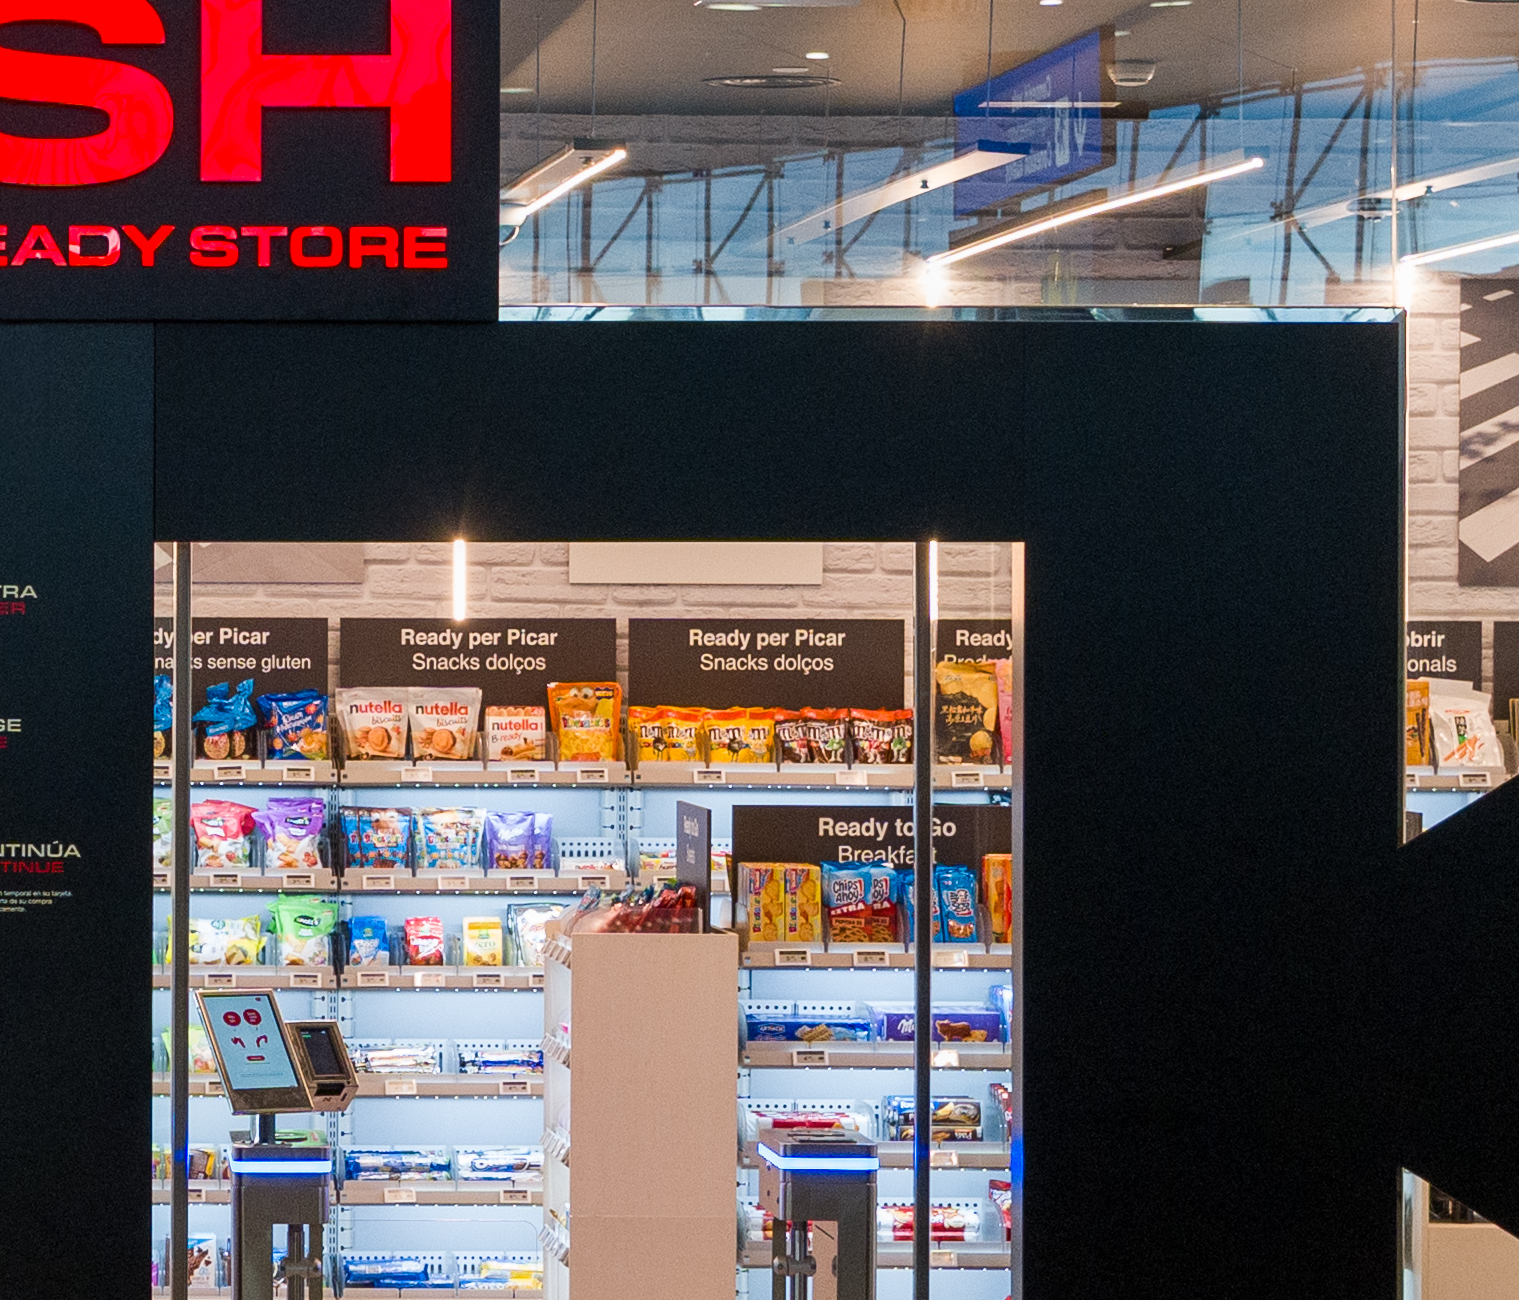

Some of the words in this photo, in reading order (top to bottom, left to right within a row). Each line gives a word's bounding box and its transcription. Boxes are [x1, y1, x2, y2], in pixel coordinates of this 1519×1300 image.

[189, 223, 449, 268] STORE
[219, 627, 270, 645] Picar
[401, 628, 463, 650] Ready
[469, 631, 501, 650] per
[507, 628, 558, 646] Picar
[689, 628, 751, 651] Ready
[756, 632, 789, 651] per
[795, 628, 846, 647] Picar
[956, 629, 1012, 651] Ready
[207, 657, 256, 670] sense
[261, 654, 312, 674] gluten
[412, 653, 480, 671] Snacks
[485, 653, 547, 675] dolços
[700, 653, 769, 672] Snacks
[773, 653, 834, 676] dolços
[349, 700, 403, 715] nutella
[415, 700, 469, 716] nutella
[492, 718, 539, 731] nutella
[818, 817, 889, 841] Ready
[894, 818, 914, 837] to
[838, 845, 937, 865] Breakfat
[832, 878, 861, 894] Chips
